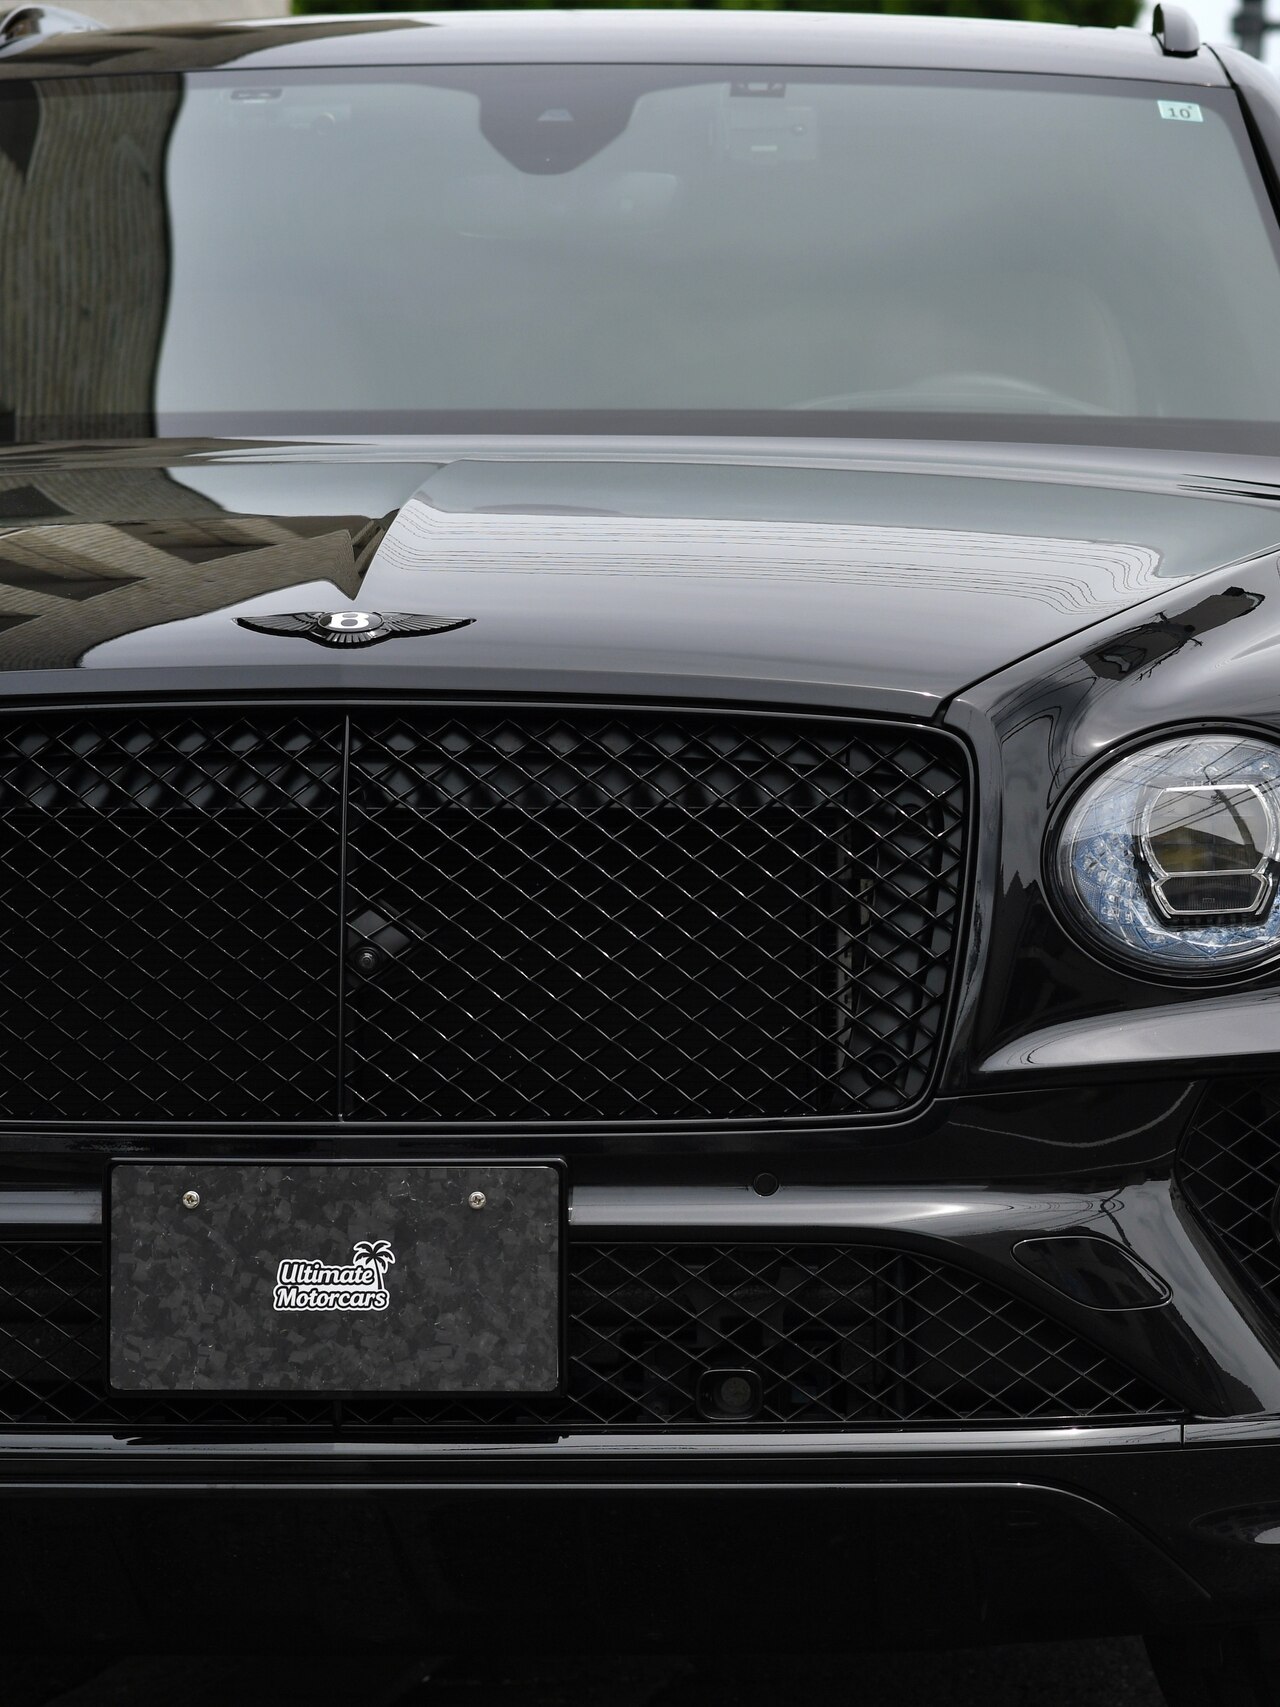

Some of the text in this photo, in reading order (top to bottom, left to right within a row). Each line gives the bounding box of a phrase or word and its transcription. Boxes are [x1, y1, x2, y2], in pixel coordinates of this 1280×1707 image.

[1168, 107, 1190, 118] 10
[327, 611, 370, 629] B
[280, 1262, 374, 1285] Ultimate
[276, 1286, 387, 1308] Motorcars
